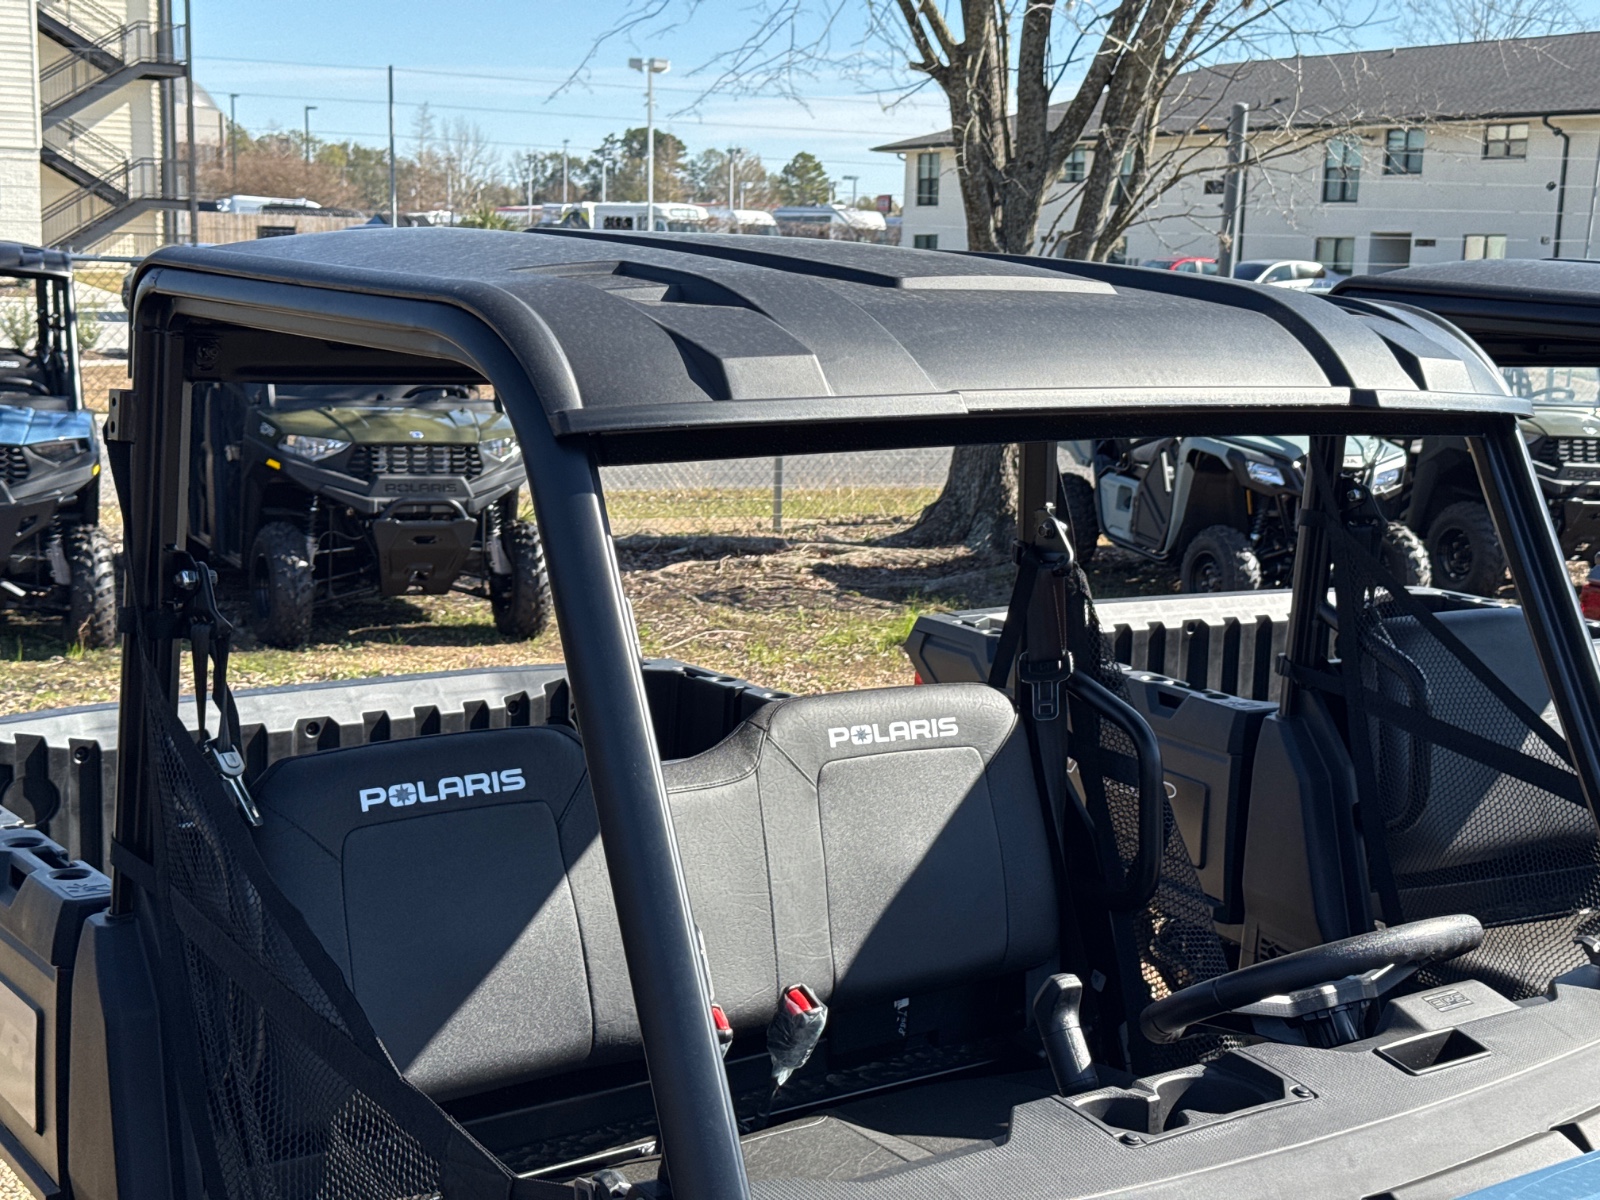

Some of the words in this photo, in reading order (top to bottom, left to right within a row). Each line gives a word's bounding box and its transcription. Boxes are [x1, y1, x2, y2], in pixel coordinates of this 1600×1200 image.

[385, 483, 457, 492] POLARIS
[827, 716, 959, 748] POLARIS
[359, 768, 526, 812] POLARIS
